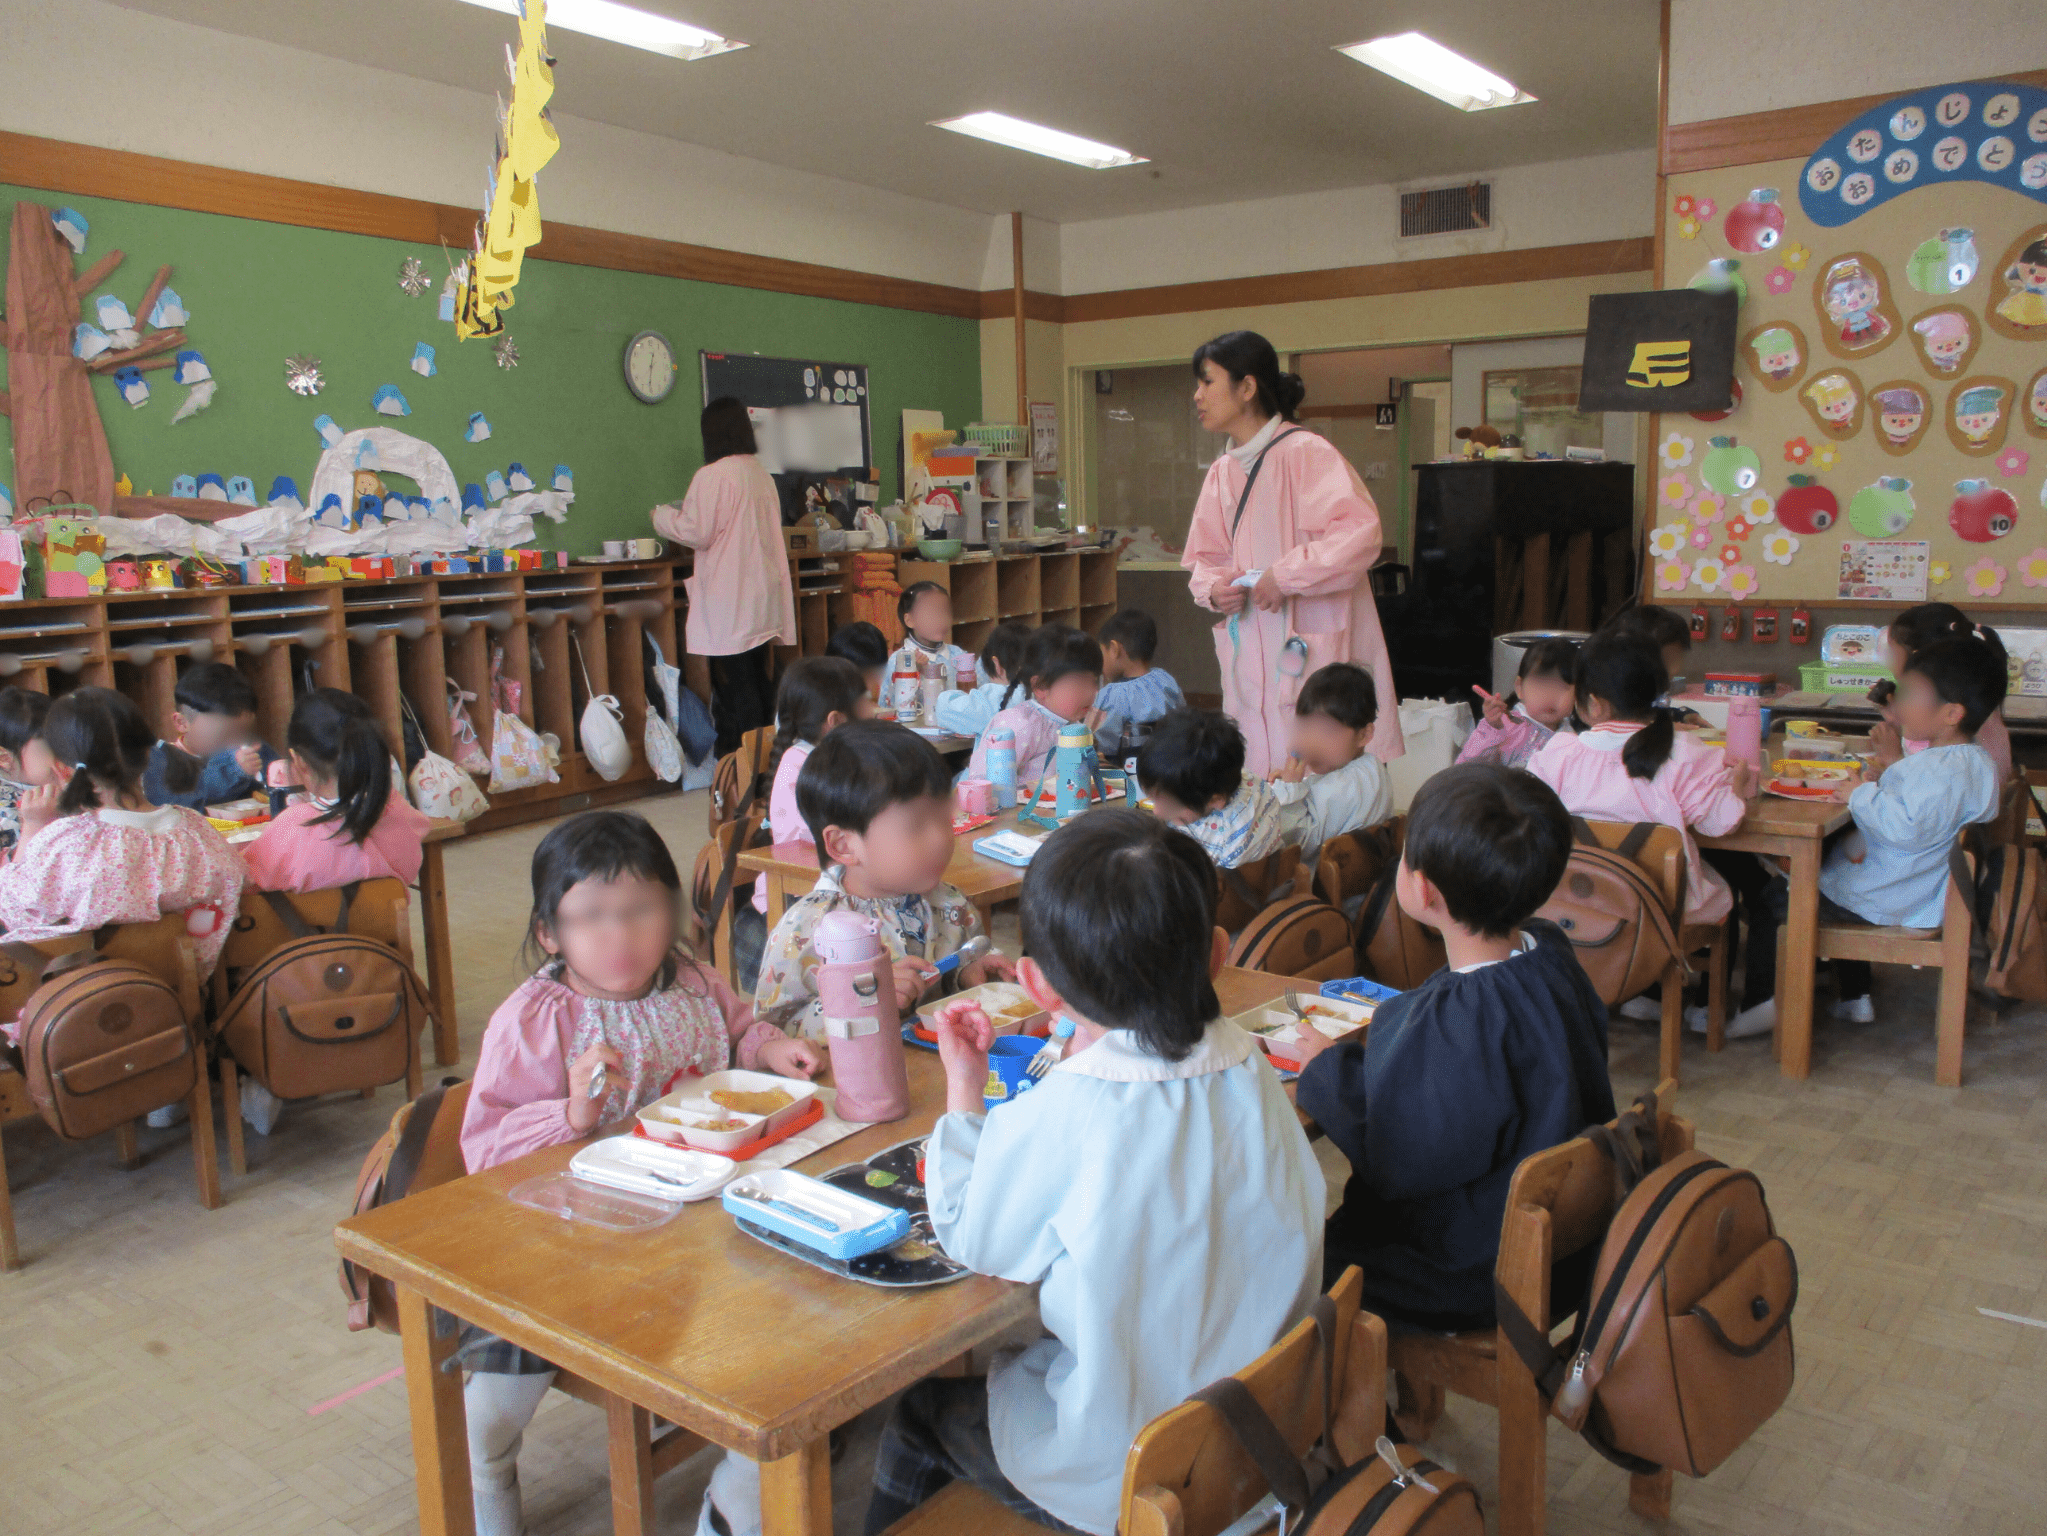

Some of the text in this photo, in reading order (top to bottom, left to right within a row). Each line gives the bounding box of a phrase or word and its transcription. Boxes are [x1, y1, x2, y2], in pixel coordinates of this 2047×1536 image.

[1955, 269, 1962, 281] 1
[1744, 474, 1751, 485] 7
[1992, 519, 2009, 531] 10
